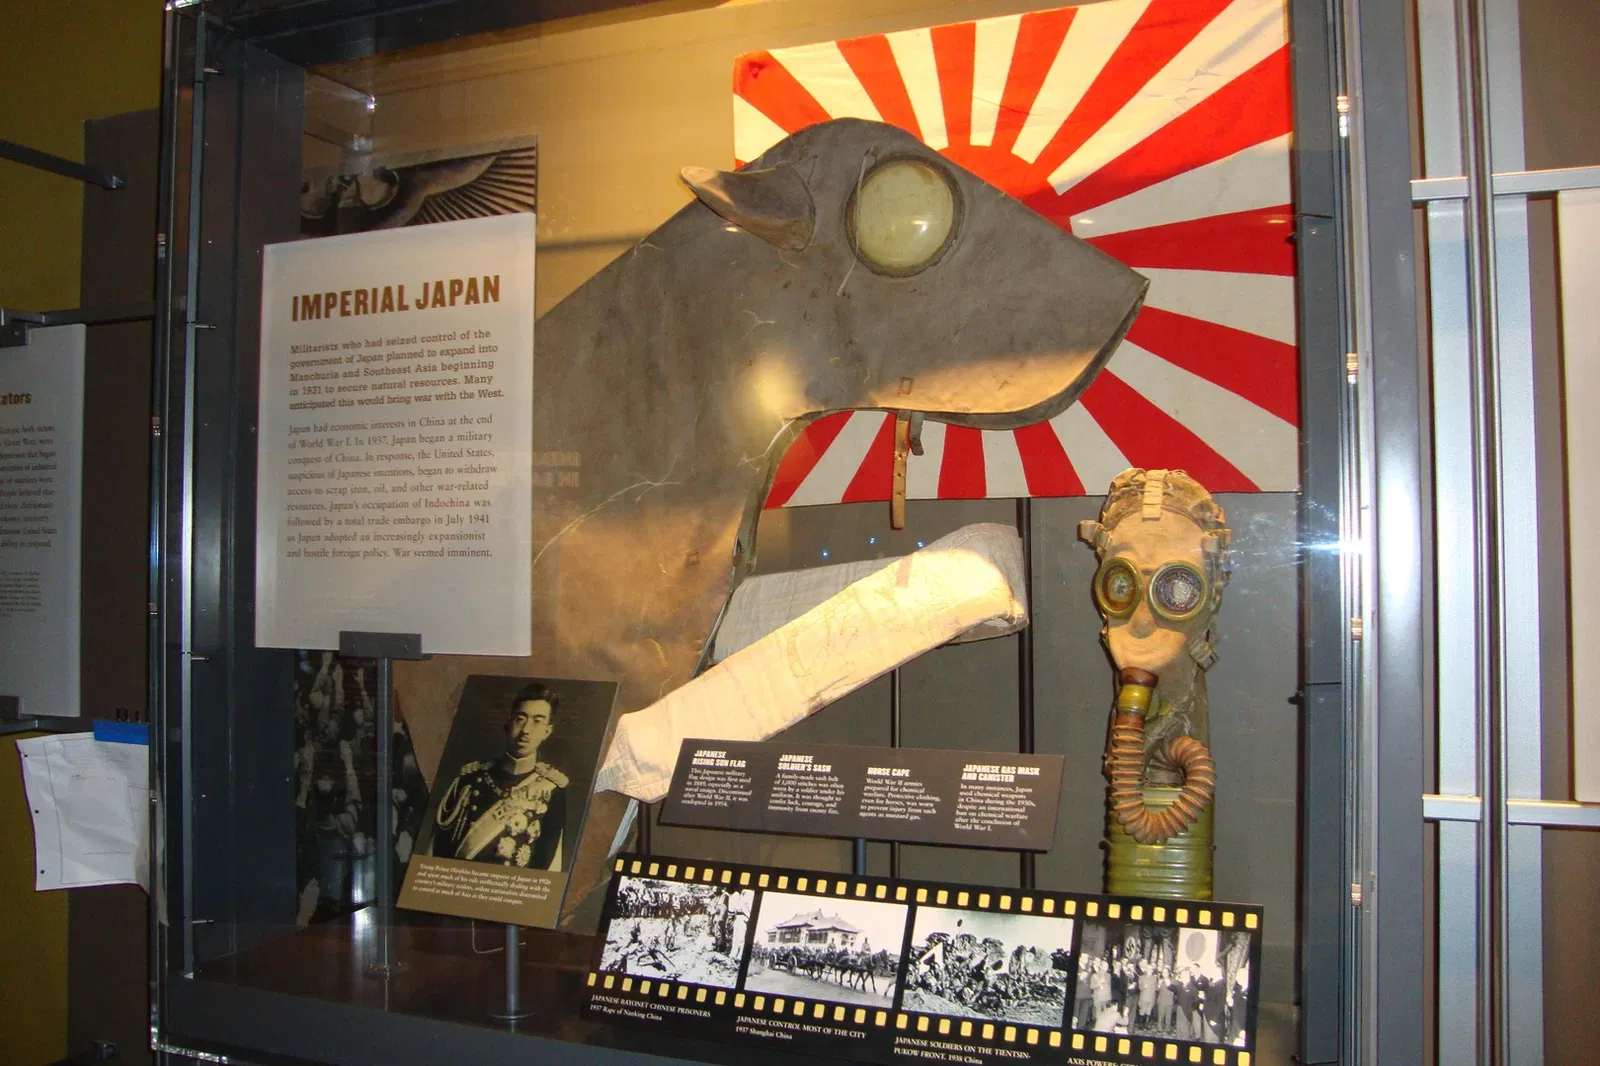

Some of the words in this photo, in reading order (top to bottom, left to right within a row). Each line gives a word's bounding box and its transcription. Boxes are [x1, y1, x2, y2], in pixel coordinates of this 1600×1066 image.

[292, 284, 409, 322] IMPERIAL
[415, 275, 499, 310] JAPAN
[291, 342, 338, 354] Militarists
[342, 340, 362, 350] who
[365, 338, 382, 348] had
[386, 336, 417, 347] seized
[420, 333, 456, 344] control
[460, 332, 470, 341] of
[474, 330, 490, 340] the
[290, 355, 342, 369] government
[345, 354, 354, 364] of
[356, 352, 383, 364] Japan
[386, 350, 424, 362] planned
[427, 349, 436, 358] to
[440, 346, 475, 358] expand
[478, 344, 498, 354] into
[290, 370, 339, 381] Manchuria
[342, 368, 360, 378] and
[363, 365, 411, 377] Southeast
[415, 363, 437, 373] Asia
[441, 360, 494, 373] beginning
[290, 386, 298, 395] in
[302, 385, 321, 395] 1931
[325, 384, 334, 393] to
[371, 380, 406, 390] natural
[410, 380, 460, 388] resources.
[464, 375, 493, 386] Many
[0, 392, 32, 405] ators
[289, 398, 336, 411] anticipated
[338, 397, 354, 407] this
[357, 396, 384, 406] would
[387, 394, 411, 405] bring
[435, 392, 456, 401] with
[459, 391, 475, 400] the
[478, 389, 504, 399] West.
[288, 424, 310, 436] Japan
[313, 423, 328, 432] had
[330, 421, 368, 432] economic
[371, 419, 404, 430] interests
[408, 418, 416, 428] in
[419, 417, 445, 427] China
[448, 416, 456, 426] at
[460, 416, 473, 425] the
[476, 415, 492, 425] end
[288, 439, 296, 448] of
[299, 438, 323, 448] World
[326, 437, 343, 447] War
[355, 437, 364, 446] In
[391, 435, 416, 447] Japan
[419, 434, 444, 446] began
[457, 432, 492, 445] military
[288, 454, 321, 467] conquest
[324, 454, 333, 463] of
[365, 452, 374, 462] In
[418, 450, 431, 460] the
[434, 449, 463, 459] United
[288, 470, 325, 482] suspicious
[327, 470, 335, 479] of
[337, 468, 371, 481] Japanese
[417, 466, 442, 478] began
[445, 466, 454, 475] to
[457, 464, 497, 475] withdraw
[315, 485, 323, 494] to
[326, 488, 347, 497] scrap
[391, 484, 407, 493] and
[410, 483, 433, 492] other
[438, 482, 488, 492] war-related
[362, 500, 409, 512] occupation
[412, 499, 421, 508] of
[425, 499, 469, 508] Indochina
[287, 517, 321, 526] followed
[324, 517, 333, 528] by
[344, 516, 364, 526] total
[368, 516, 389, 525] trade
[393, 515, 431, 528] embargo
[434, 515, 443, 524] in
[446, 515, 464, 527] July
[469, 515, 489, 524] 1941
[298, 532, 320, 544] Japan
[324, 532, 357, 544] adopted
[373, 532, 424, 544] increasingly
[428, 532, 485, 544] expansionist
[287, 548, 301, 557] and
[304, 548, 329, 557] hostile
[332, 548, 360, 560] foreign
[393, 548, 410, 557] War
[414, 548, 444, 557] seemed
[694, 750, 726, 759] JAPANESE
[780, 755, 812, 764] JAPANESE
[692, 758, 714, 766] RISING
[715, 759, 729, 767] SUN
[730, 760, 746, 768] FLAG
[778, 762, 812, 771] SOLDIER'S
[813, 764, 831, 772] SASH
[963, 764, 999, 774] JAPANESE
[1001, 766, 1016, 775] GAS
[1017, 767, 1039, 776] MASK
[868, 767, 890, 776] HORSE
[892, 769, 909, 777] CAPE
[962, 773, 977, 781] AND
[978, 773, 1014, 783] CANISTER
[590, 1003, 602, 1011] 1937
[603, 1004, 615, 1014] Rape
[624, 1008, 645, 1019] Nanking
[646, 1011, 662, 1020] China
[592, 994, 619, 1004] JAPANESE
[621, 998, 648, 1008] BAYONET
[650, 1002, 675, 1012] CHINESE
[677, 1006, 710, 1017] PRISONERS
[736, 1025, 748, 1034] 1937
[750, 1027, 774, 1038] Shanghai
[775, 1030, 792, 1039] China
[737, 1015, 766, 1026] JAPANESE
[768, 1019, 800, 1030] CONTROL
[803, 1024, 821, 1033] MOST
[823, 1026, 832, 1034] OF
[834, 1028, 847, 1036] THE
[849, 1029, 866, 1038] CITY
[895, 1036, 927, 1047] JAPANESE
[930, 1040, 962, 1051] SOLDIERS
[964, 1044, 975, 1052] ON
[978, 1046, 992, 1054] THE
[894, 1046, 919, 1056] PUKOW
[948, 1053, 962, 1061] 1938
[964, 1054, 982, 1064] China
